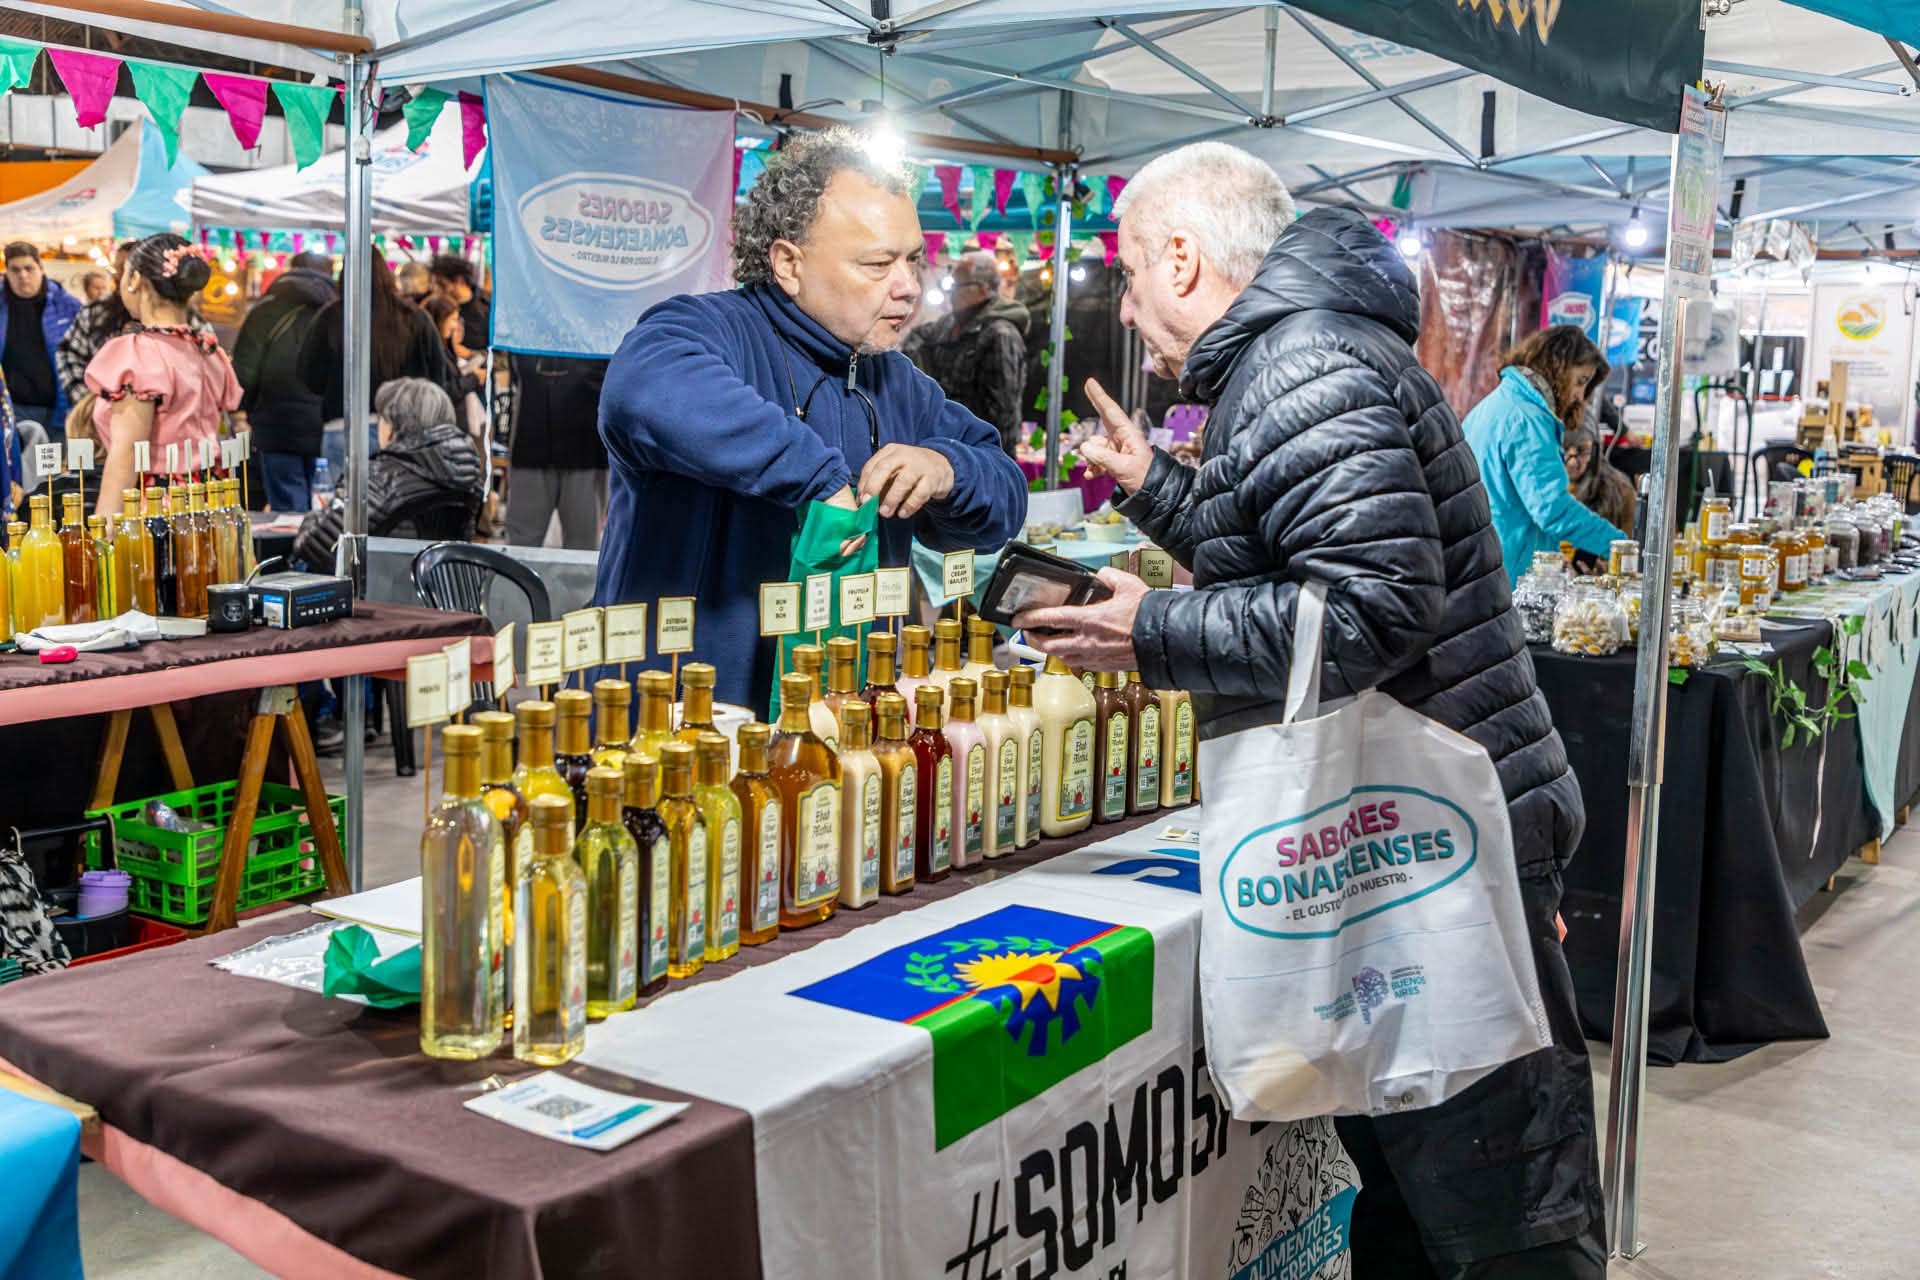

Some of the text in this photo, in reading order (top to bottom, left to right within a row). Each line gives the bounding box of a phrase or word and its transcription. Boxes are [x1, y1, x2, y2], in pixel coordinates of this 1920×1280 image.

[1292, 908, 1306, 921] EL
[1346, 885, 1359, 897] LO
[1360, 872, 1407, 894] NUESTRO
[1248, 1204, 1332, 1280] ALIMENTOS
